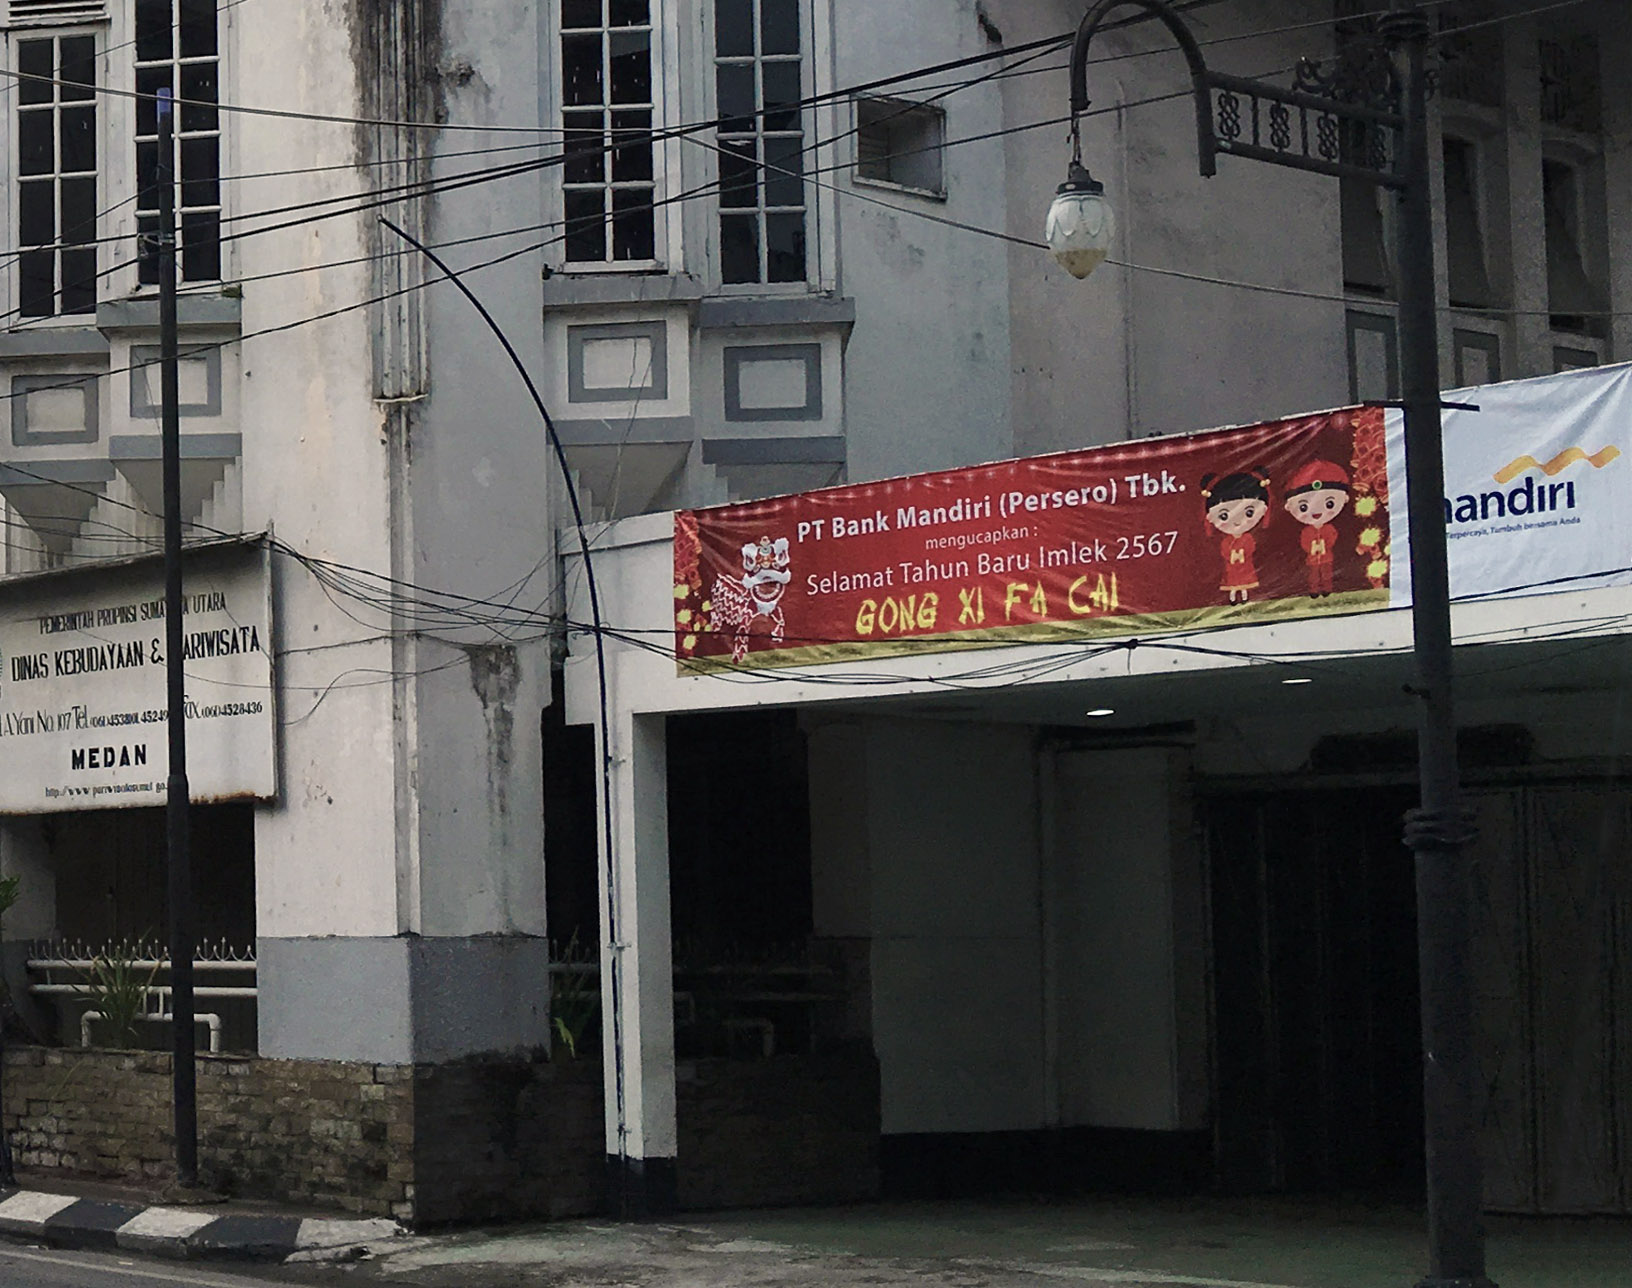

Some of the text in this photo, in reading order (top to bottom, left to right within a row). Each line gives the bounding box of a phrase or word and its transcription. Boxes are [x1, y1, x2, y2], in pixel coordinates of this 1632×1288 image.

[798, 470, 1186, 543] PT Bank Mandiri (Persero) Tbk.
[1559, 515, 1581, 525] Anda
[926, 526, 1029, 551] mengucapkan
[807, 531, 1178, 596] Selamat Tahun Baru Imlek 2567
[193, 592, 226, 614] UTARA
[856, 572, 1120, 636] GONG XI FA CAI
[11, 625, 260, 682] DINAS KEBUDAYAAN & ARIWISATA
[72, 744, 147, 771] MEDAN
